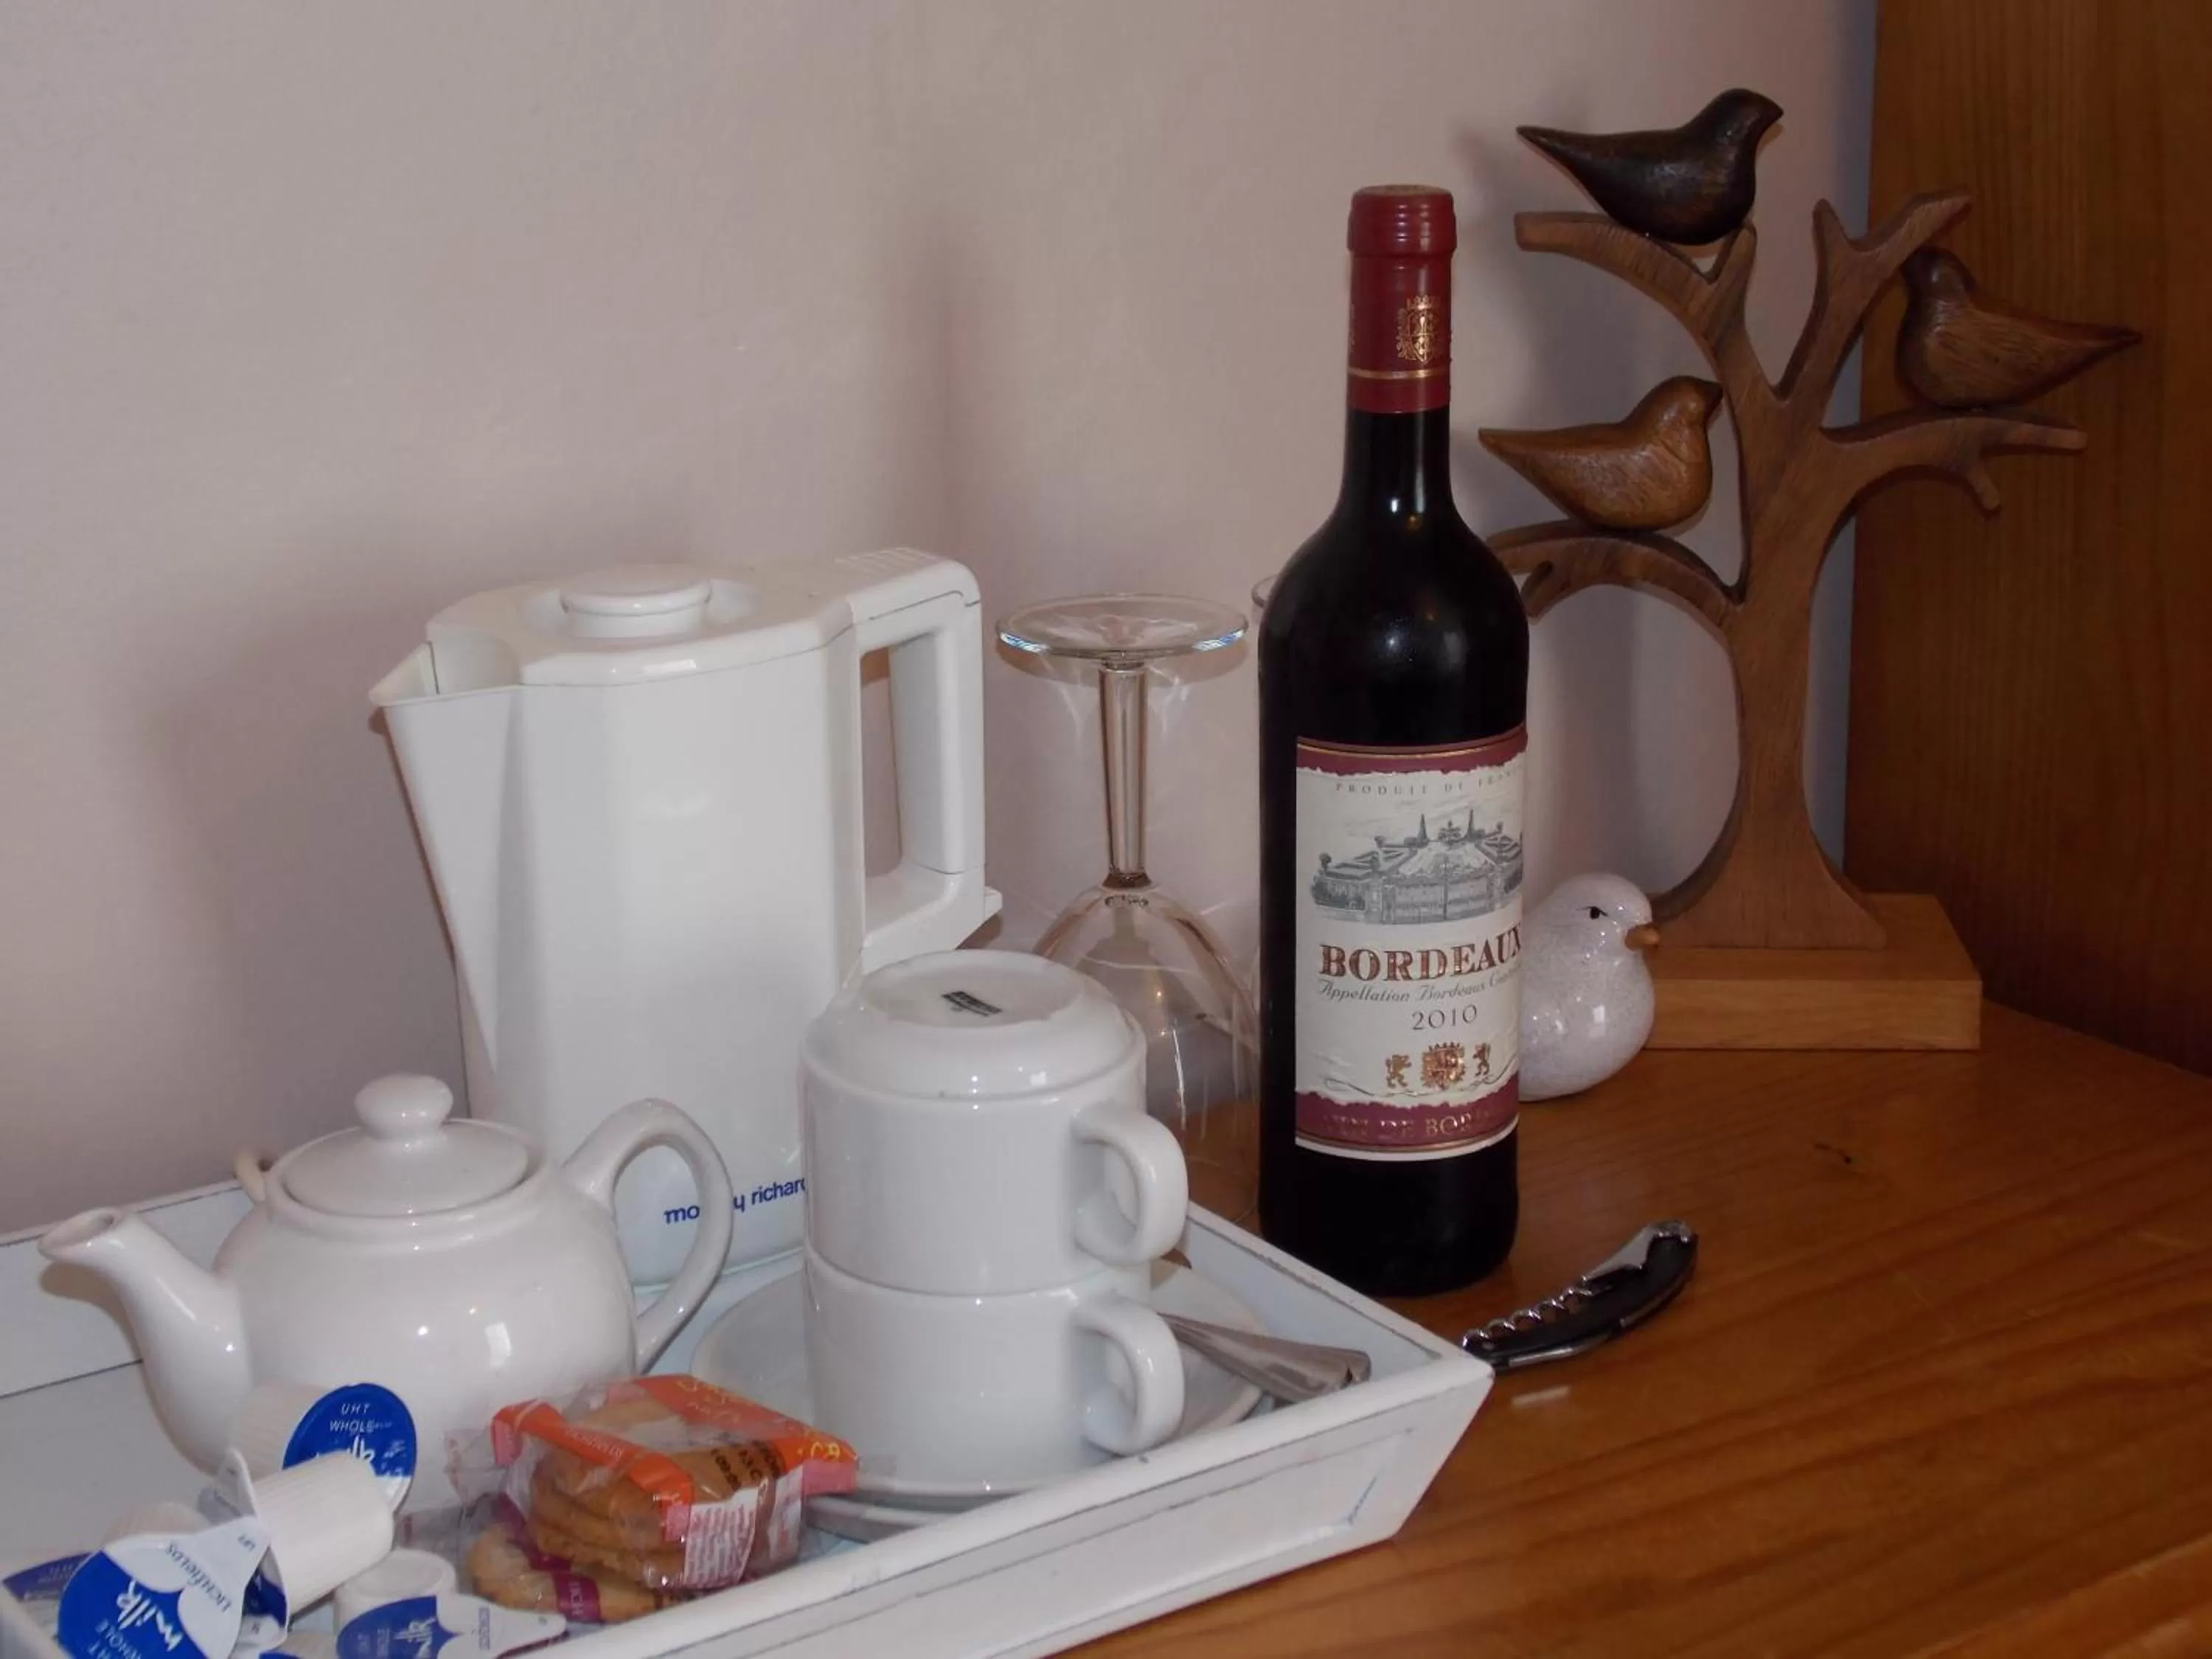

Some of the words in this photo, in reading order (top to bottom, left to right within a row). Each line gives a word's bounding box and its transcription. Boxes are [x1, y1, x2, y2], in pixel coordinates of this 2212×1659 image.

[1335, 782, 1428, 795] PRODUIT
[1318, 923, 1521, 981] BORDEAUX
[1318, 979, 1411, 1003] Appellation
[1416, 982, 1486, 1001] Bordeaux
[1411, 1005, 1478, 1031] 2010
[341, 1402, 370, 1416] UHT
[116, 1579, 184, 1652] milk
